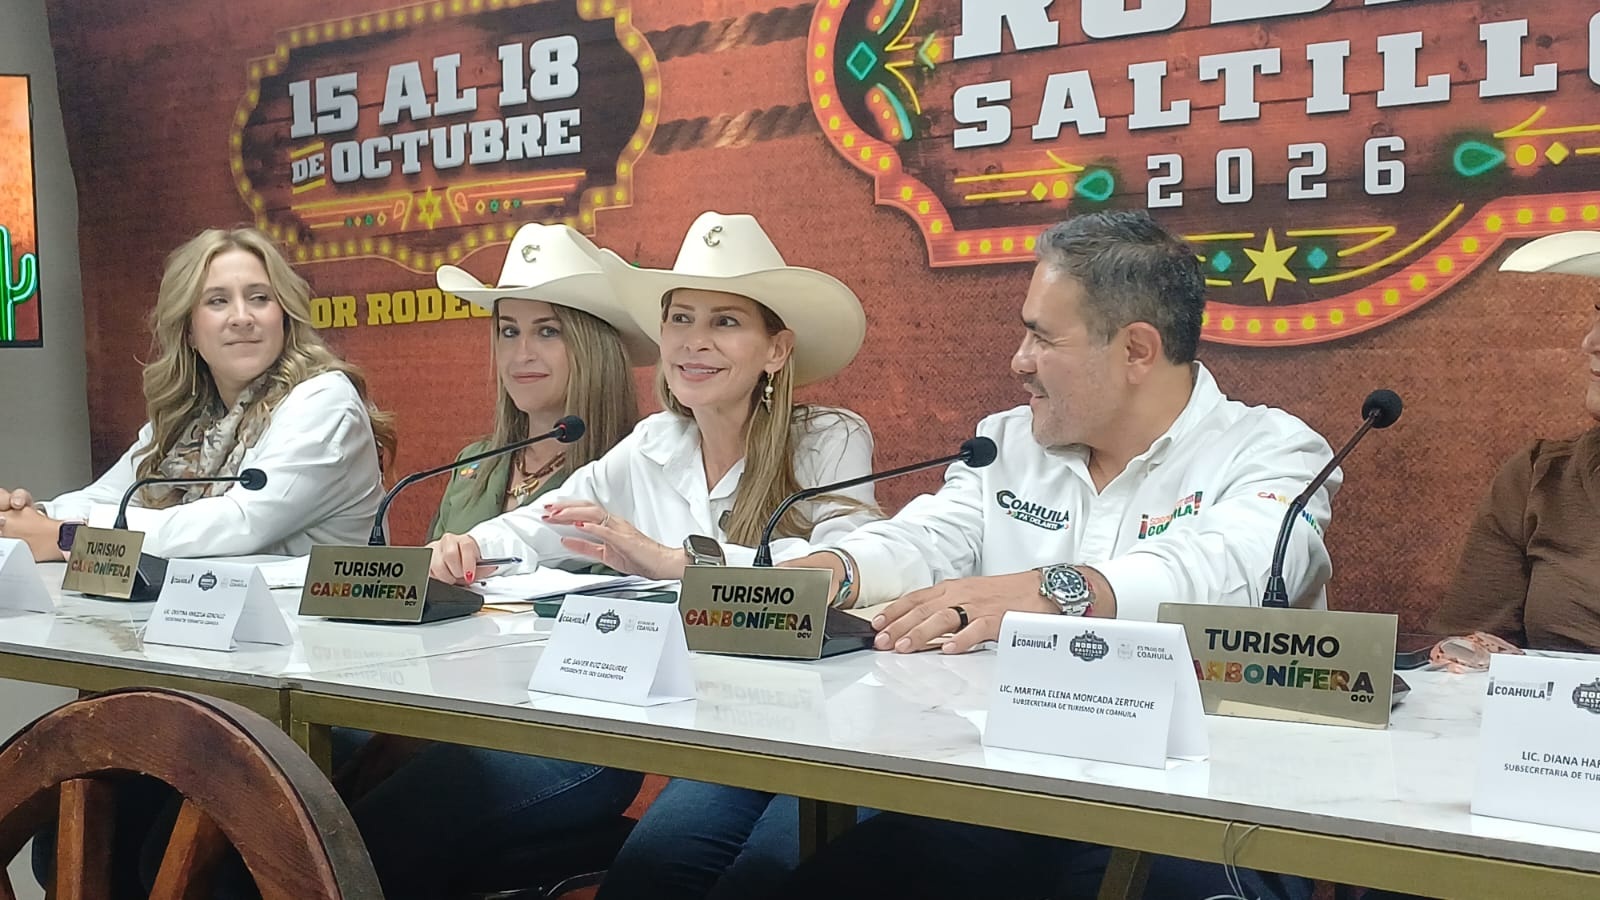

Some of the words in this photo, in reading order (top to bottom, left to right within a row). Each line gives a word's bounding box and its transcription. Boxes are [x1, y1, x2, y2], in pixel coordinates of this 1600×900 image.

[288, 72, 358, 139] 15
[378, 53, 477, 125] AL
[498, 35, 580, 106] 18
[953, 11, 1600, 149] SALTILL
[291, 154, 325, 184] DE
[330, 109, 581, 184] OCTUBRE
[1147, 136, 1405, 208] 2026
[996, 490, 1070, 522] COAHUILA
[86, 542, 126, 558] TURISMO
[333, 561, 404, 578] TURISMO
[310, 581, 418, 600] CARBONÍFERA
[711, 584, 795, 605] TURISMO
[685, 607, 812, 632] CARBONÍFERA
[1204, 629, 1340, 658] TURISMO
[1137, 651, 1174, 661] COAHUILA
[1193, 660, 1375, 694] ARBONÍFERA
[1012, 698, 1057, 709] SUBSECRETARIA
[1067, 704, 1095, 714] TURISMO
[1105, 708, 1137, 718] COAHUILA
[1014, 686, 1046, 697] MARTHA
[1048, 690, 1071, 700] ELENA
[1072, 693, 1113, 705] MONCADA
[1114, 697, 1155, 710] ZERTUCHE
[1522, 751, 1540, 762] LIC.
[1543, 753, 1578, 766] DIANA
[1504, 763, 1569, 778] SUBSECRETARIA
[1570, 771, 1582, 780] DE
